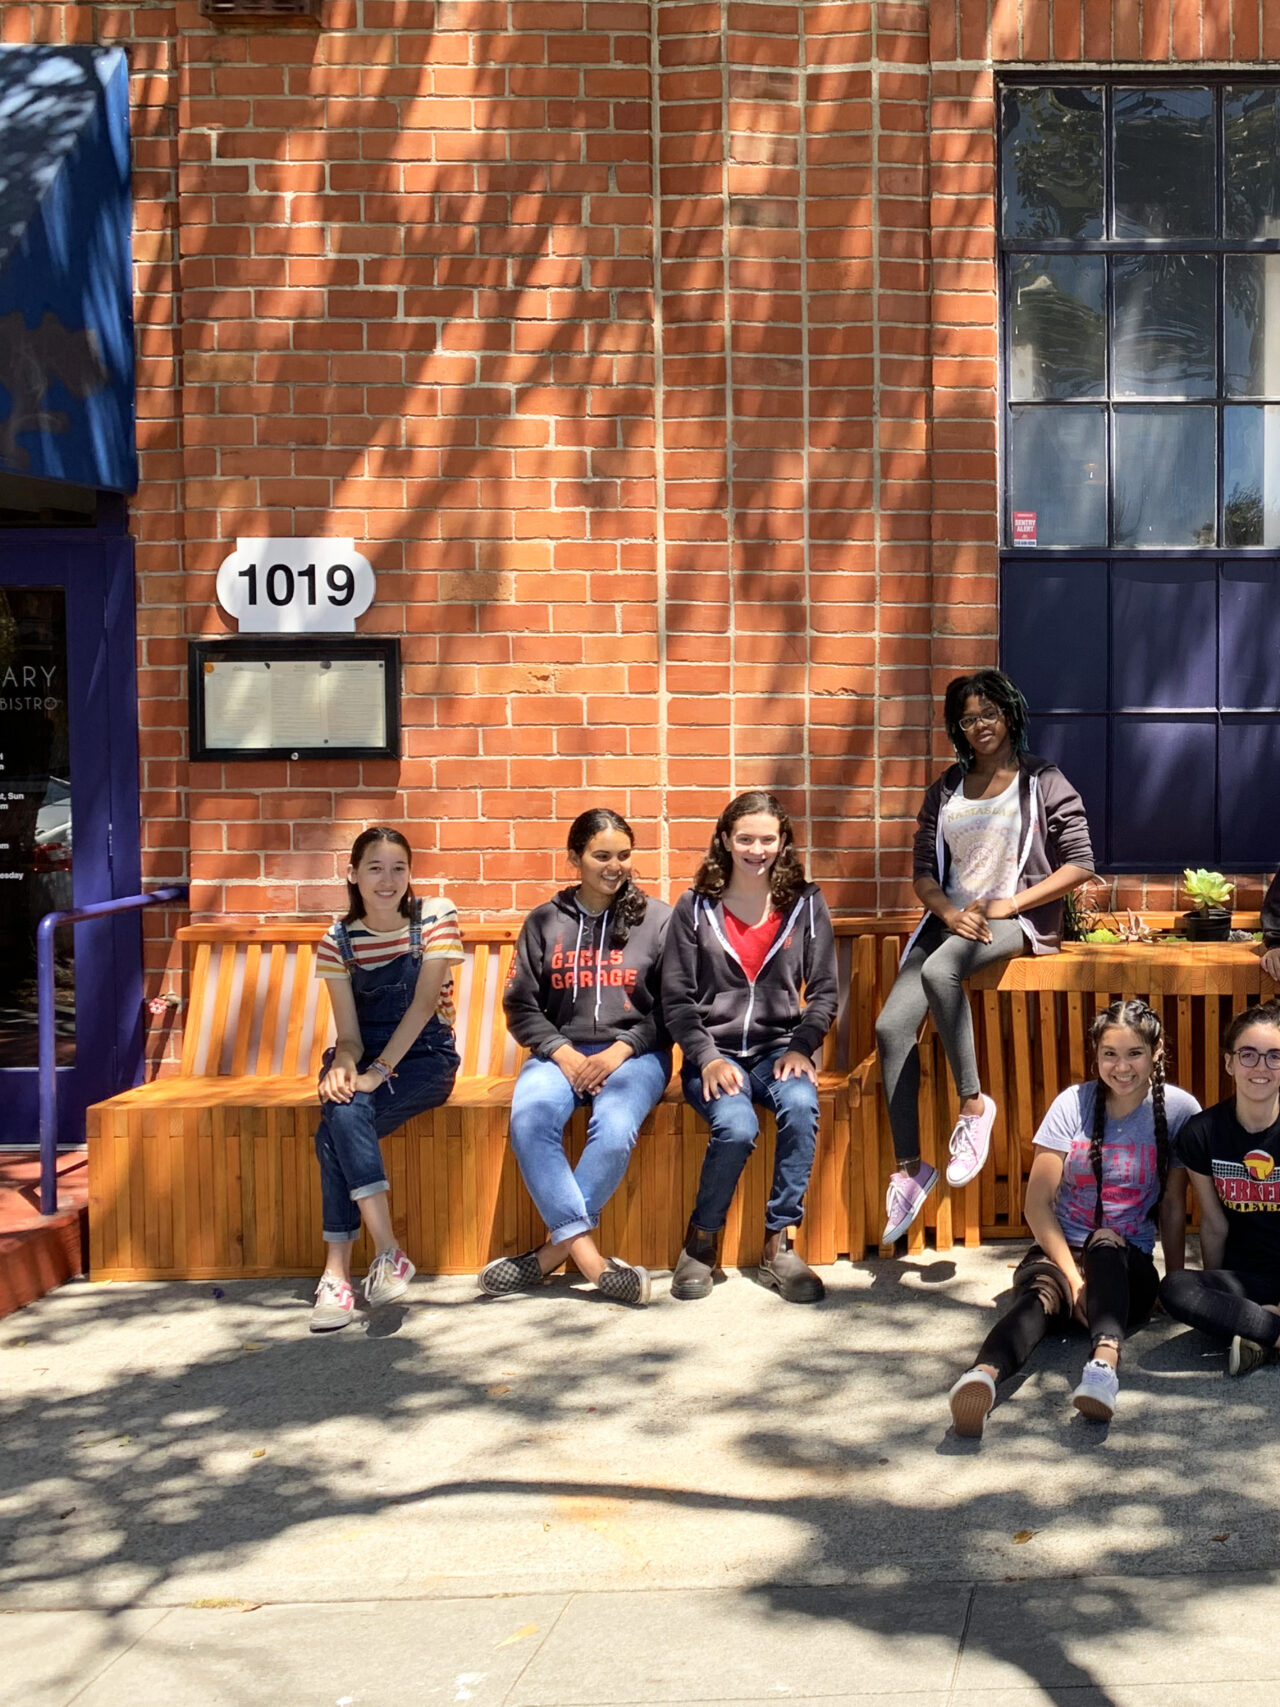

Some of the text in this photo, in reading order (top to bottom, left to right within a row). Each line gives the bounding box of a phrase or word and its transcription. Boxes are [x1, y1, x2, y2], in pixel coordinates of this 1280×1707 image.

[238, 563, 355, 606] 1019
[0, 696, 58, 710] BISTRO
[8, 792, 24, 800] Sun
[551, 949, 624, 969] GIRLS
[551, 968, 638, 990] GARAGE
